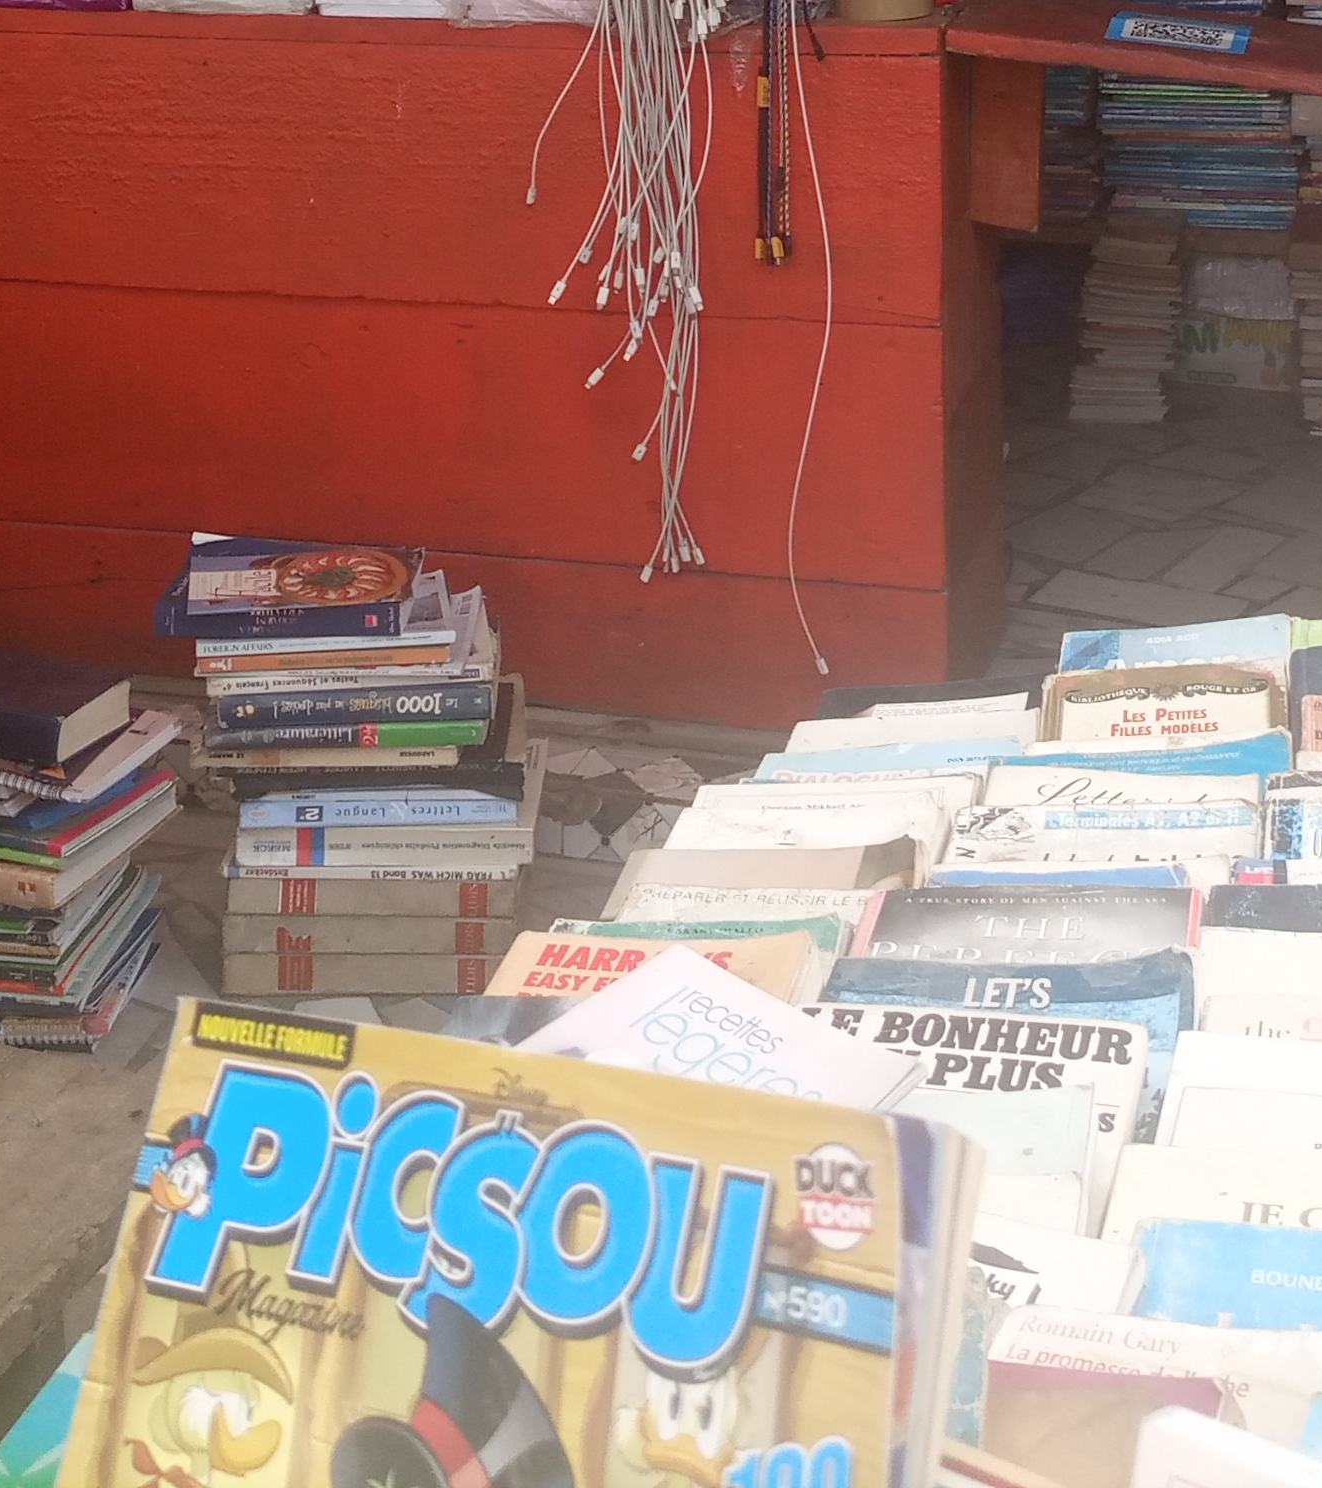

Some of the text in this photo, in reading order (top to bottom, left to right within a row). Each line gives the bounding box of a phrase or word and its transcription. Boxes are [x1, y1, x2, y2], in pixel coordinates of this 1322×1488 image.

[203, 641, 274, 653] FOREIGN AFFAIRS
[275, 727, 352, 742] Littérature
[371, 870, 380, 878] 13
[383, 870, 407, 879] Band
[411, 870, 433, 879] WAS
[438, 870, 463, 879] MICH
[975, 916, 1084, 940] THE
[522, 971, 590, 991] EASY
[963, 976, 1052, 1009] LET'S
[679, 985, 785, 1056] recettes
[196, 1013, 349, 1062] NOUVELLE FORMULE
[874, 1009, 1132, 1064] BONHEUR
[927, 1052, 1066, 1092] PLUS
[795, 1157, 874, 1201] DUCK
[800, 1198, 874, 1232] TOON
[1018, 1314, 1182, 1356] Romain Gary
